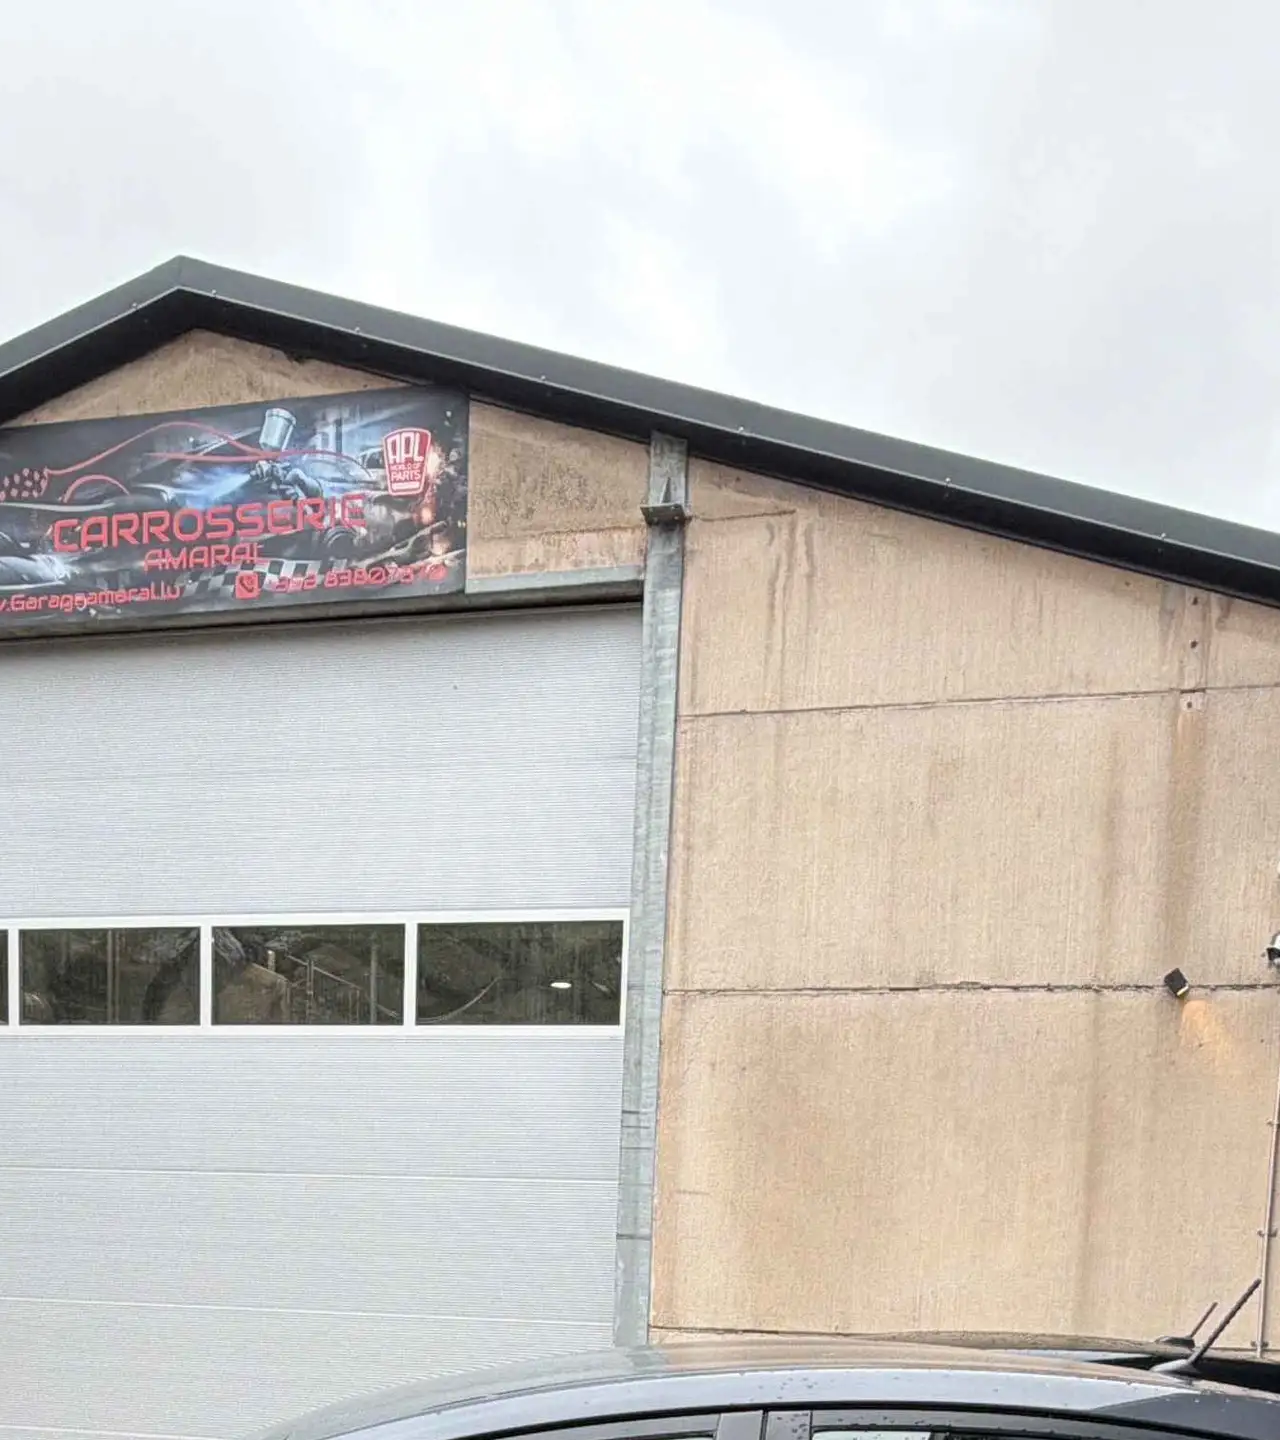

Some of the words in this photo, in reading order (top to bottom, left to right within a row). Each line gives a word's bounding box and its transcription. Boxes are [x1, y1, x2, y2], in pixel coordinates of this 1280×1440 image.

[390, 470, 421, 482] PARTS
[54, 493, 367, 553] CARROSSERIE
[144, 542, 264, 572] AMARAL
